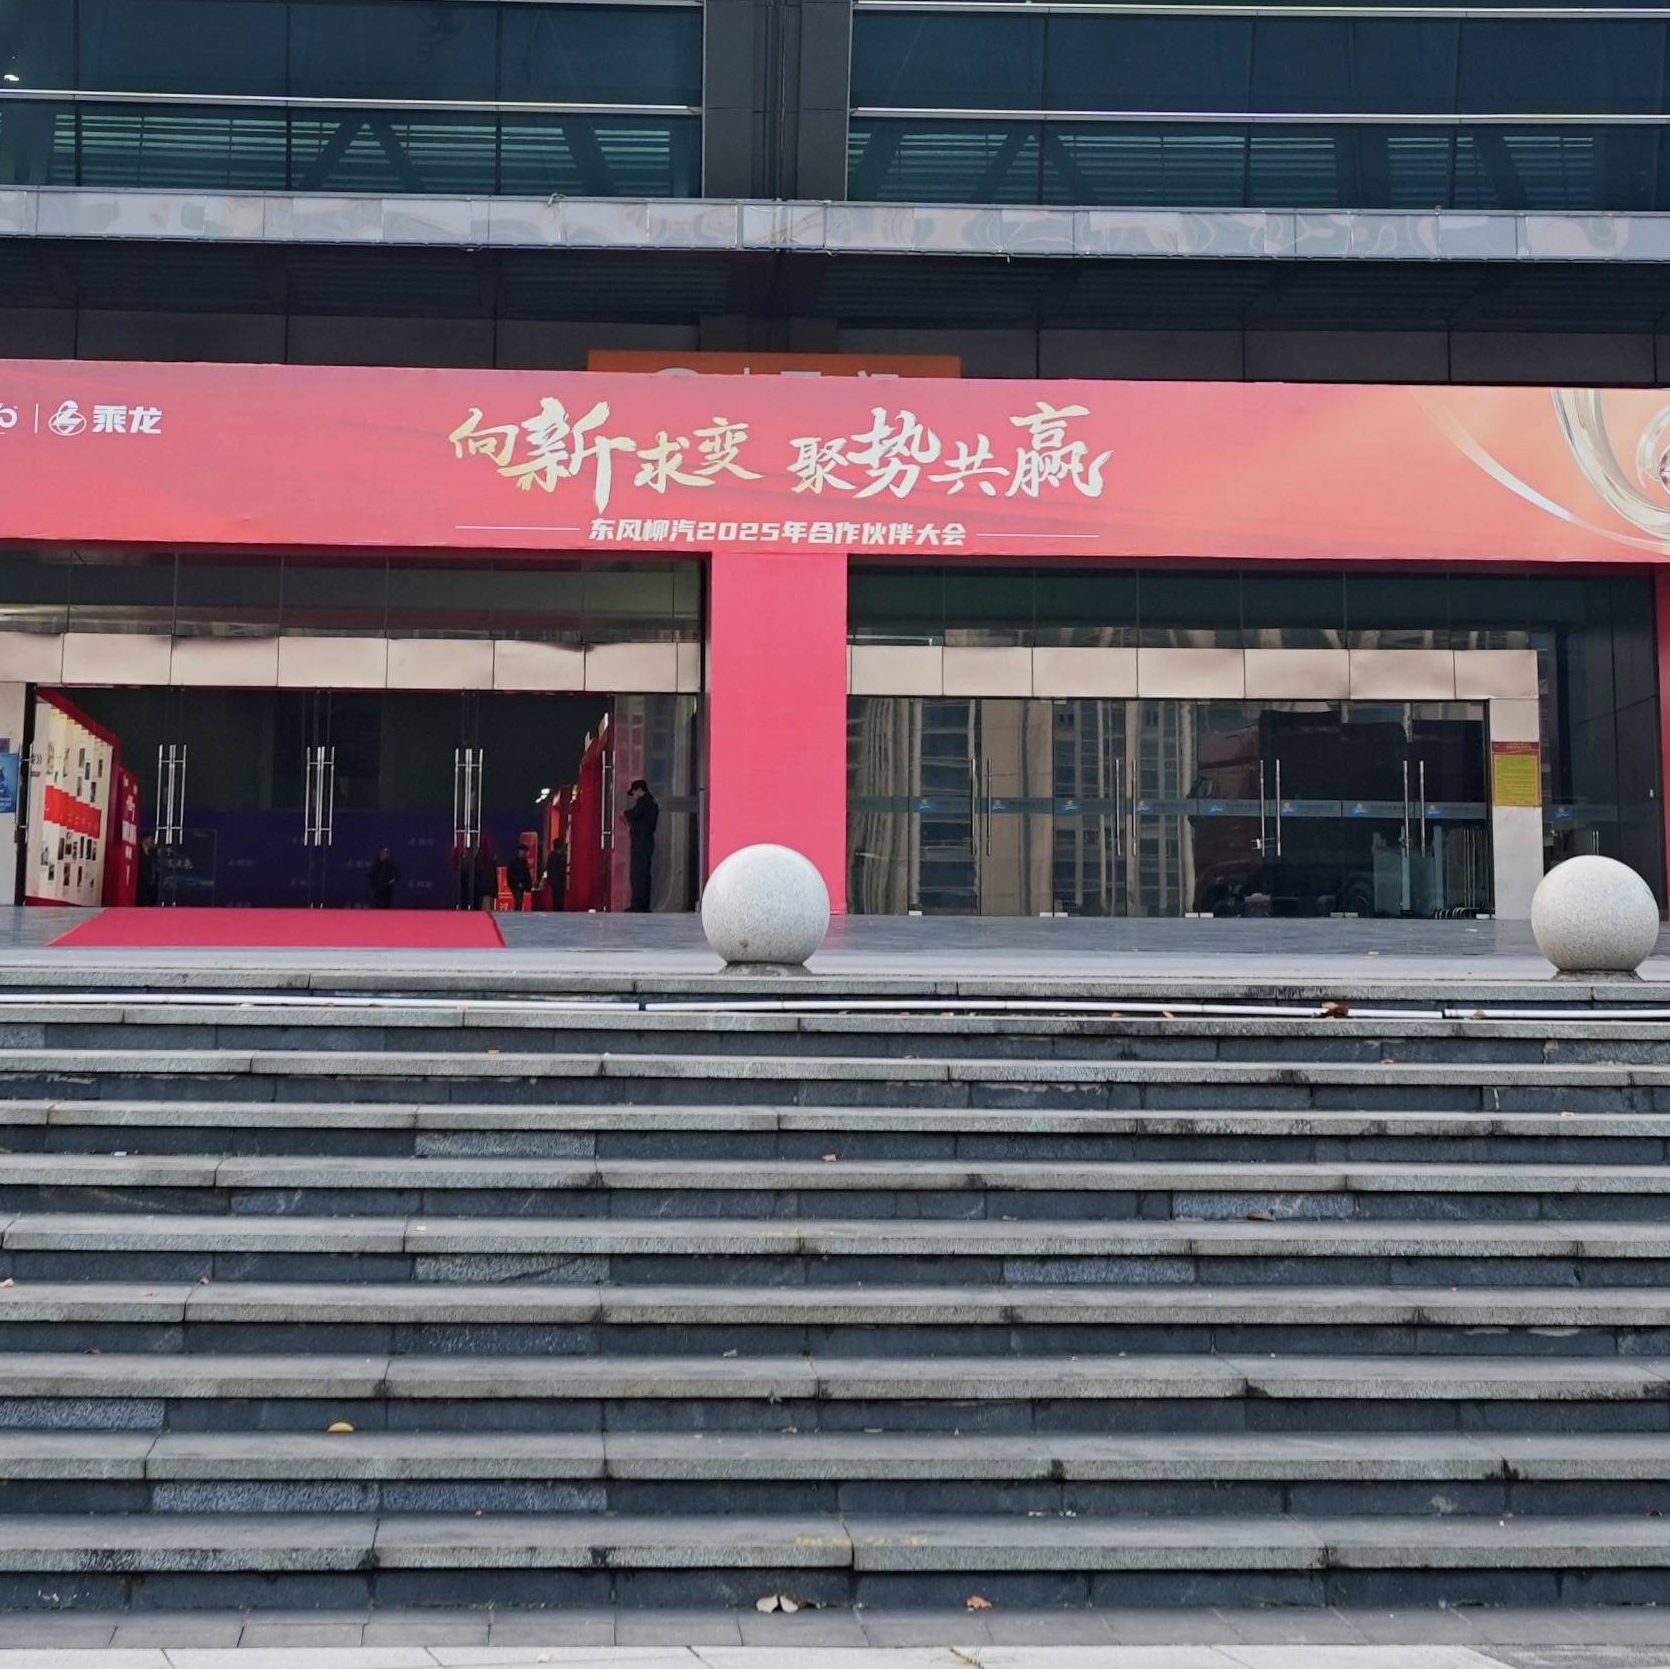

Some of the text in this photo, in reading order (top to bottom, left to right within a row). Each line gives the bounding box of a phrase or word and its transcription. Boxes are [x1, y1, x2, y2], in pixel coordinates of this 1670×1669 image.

[92, 404, 163, 434] 乘龙
[449, 396, 1112, 514] 向新求变 聚势共赢
[588, 518, 967, 546] 东风柳汽2025年合作伙伴大会
